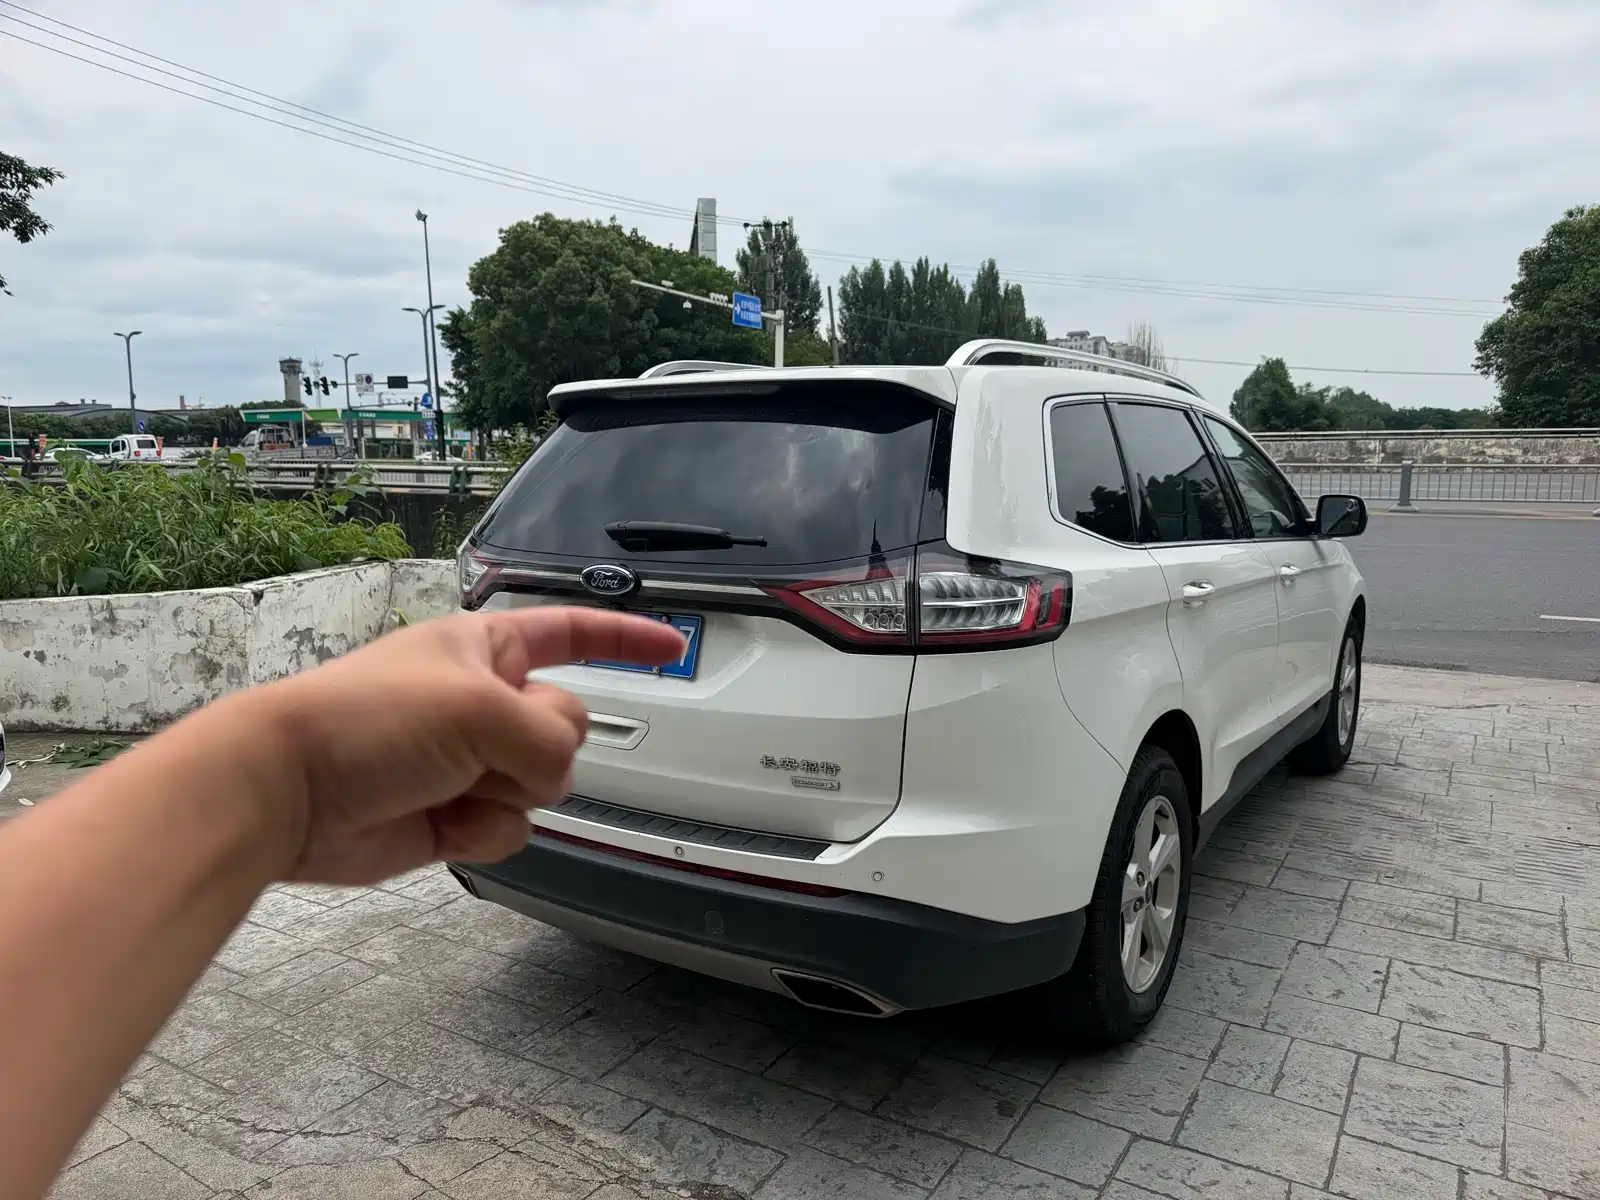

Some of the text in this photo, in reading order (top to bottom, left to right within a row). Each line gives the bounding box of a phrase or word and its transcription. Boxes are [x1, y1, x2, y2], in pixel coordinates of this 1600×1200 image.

[591, 570, 621, 589] Ford
[760, 754, 841, 777] 长安福特
